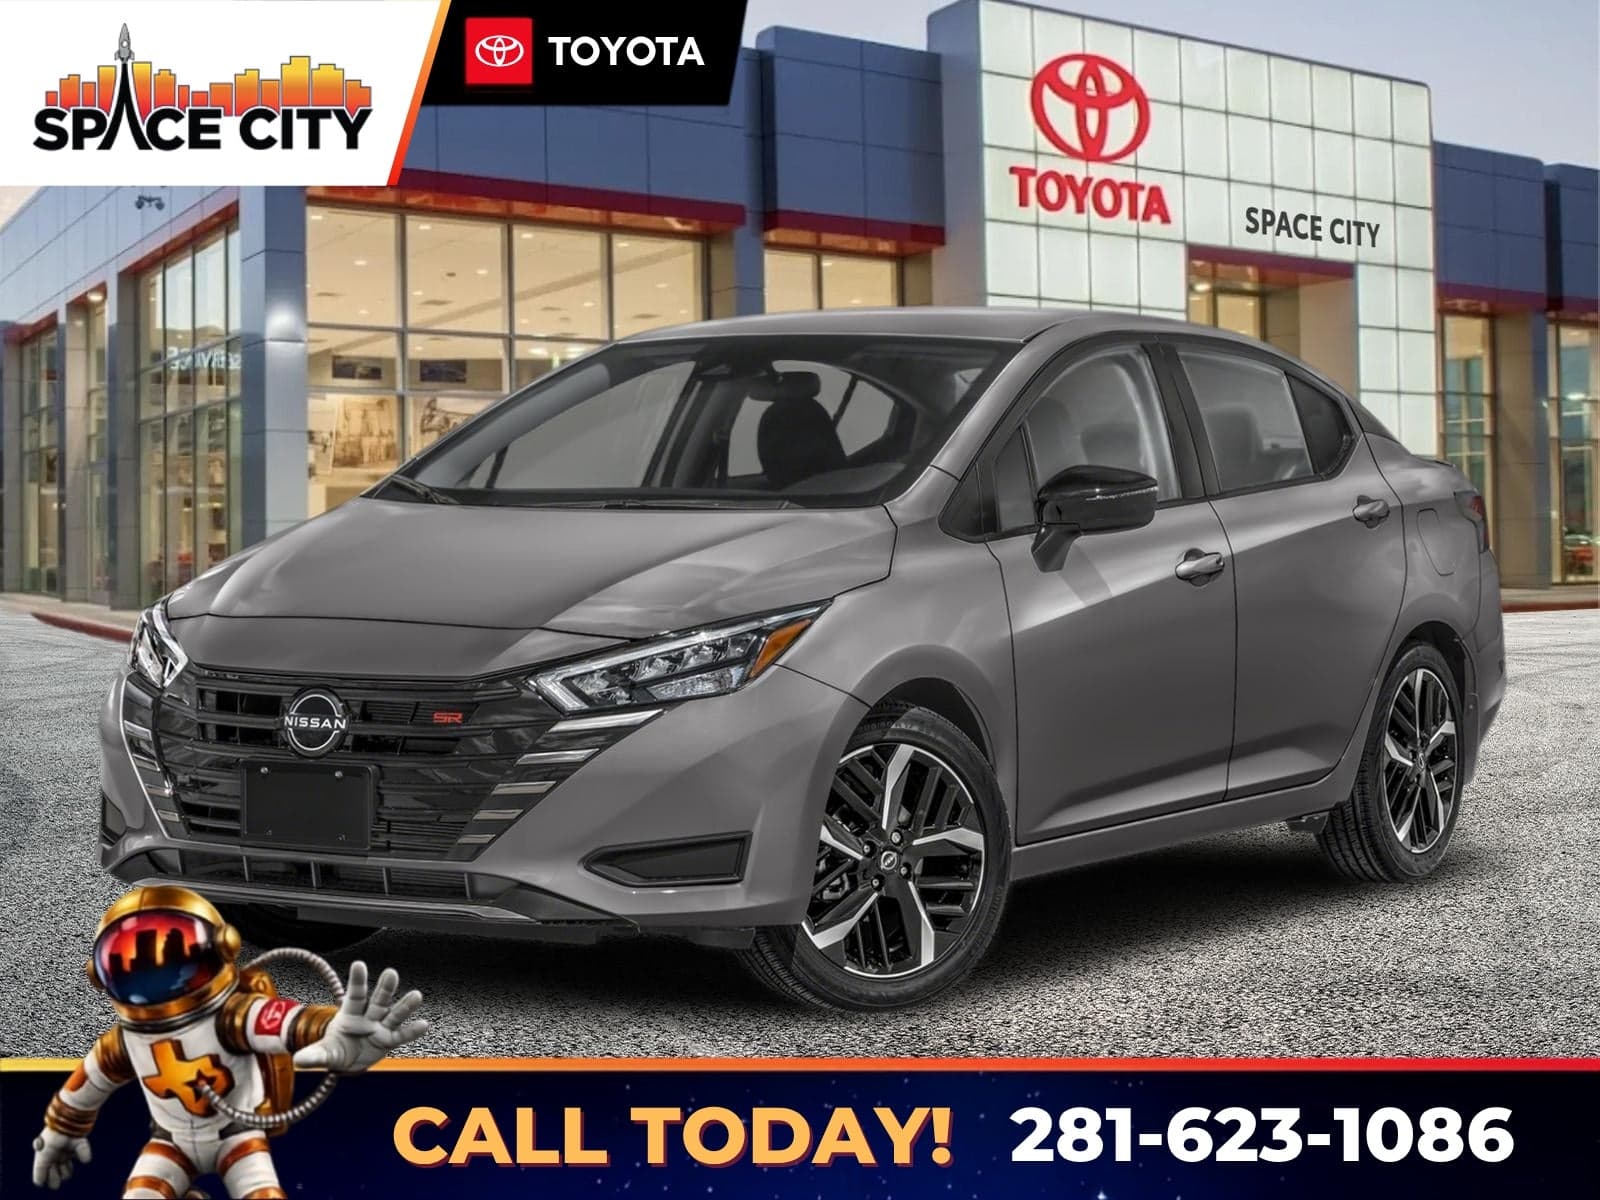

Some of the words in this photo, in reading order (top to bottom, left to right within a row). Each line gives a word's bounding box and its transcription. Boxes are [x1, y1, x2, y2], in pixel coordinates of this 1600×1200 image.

[1009, 166, 1171, 225] TOYOTA
[1244, 206, 1322, 242] SPACE
[1329, 217, 1381, 248] CITY
[283, 715, 347, 730] NISSAN
[432, 711, 463, 724] SR
